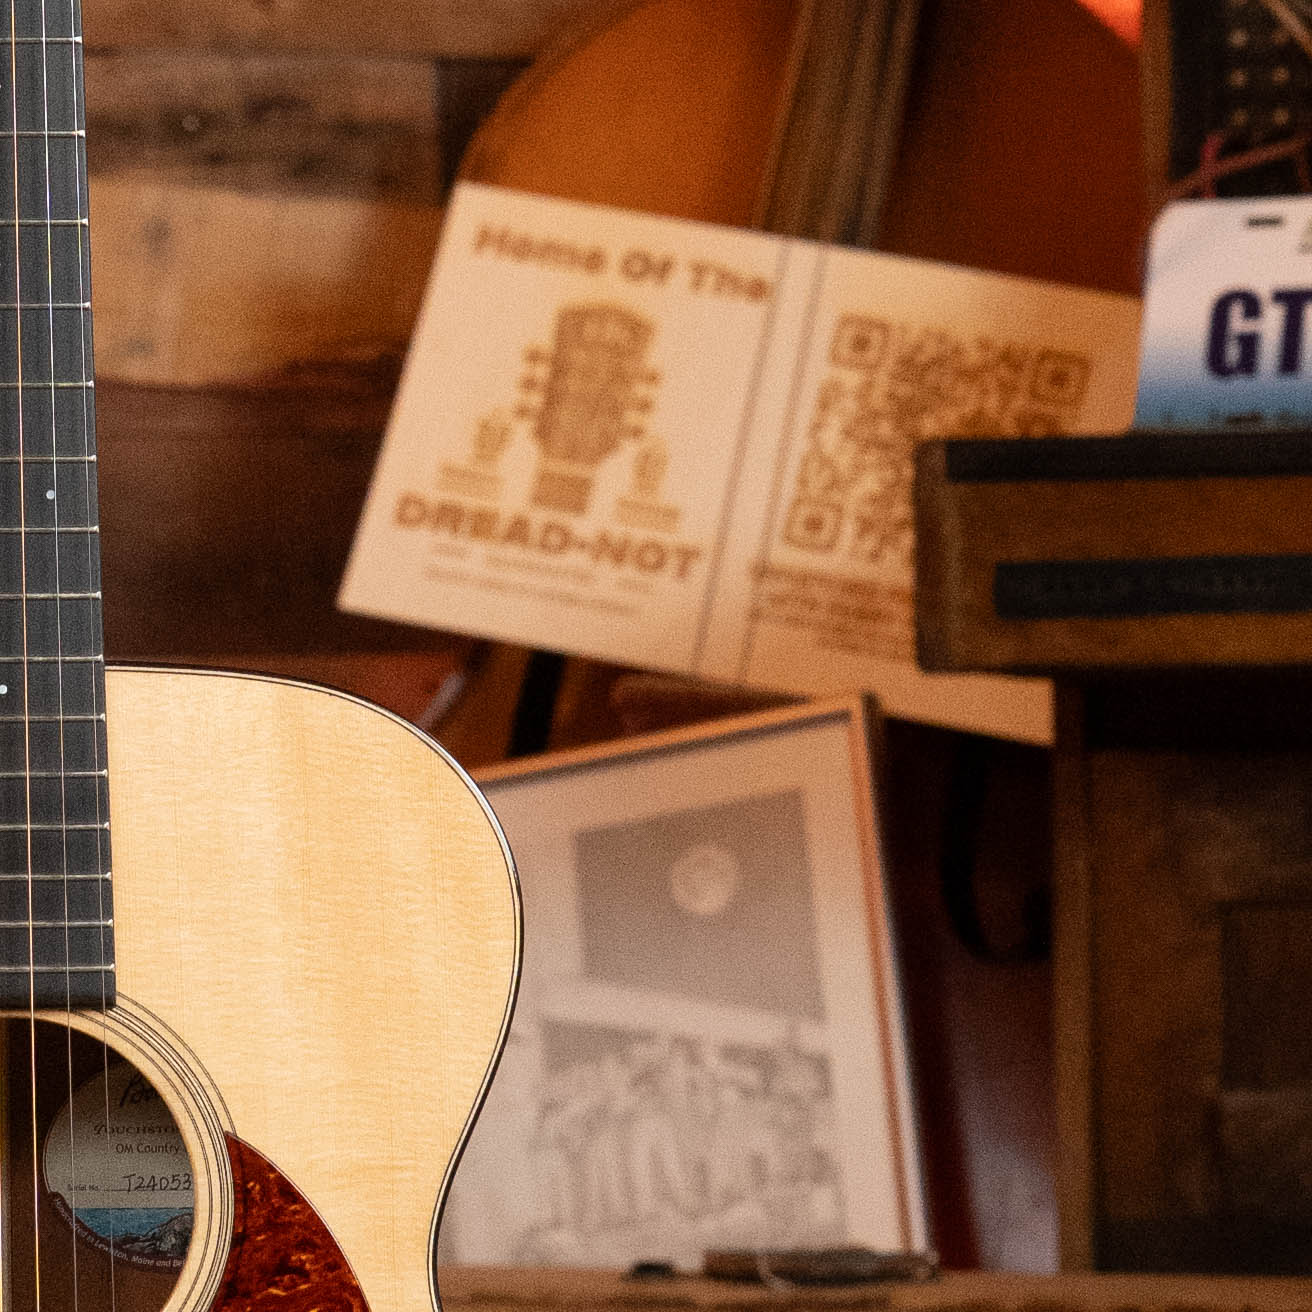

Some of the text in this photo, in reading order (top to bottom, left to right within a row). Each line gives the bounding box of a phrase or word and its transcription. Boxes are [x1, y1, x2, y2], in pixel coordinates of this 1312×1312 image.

[619, 237, 676, 283] Of
[395, 491, 702, 581] DREAD-NOT
[137, 1143, 180, 1156] Country
